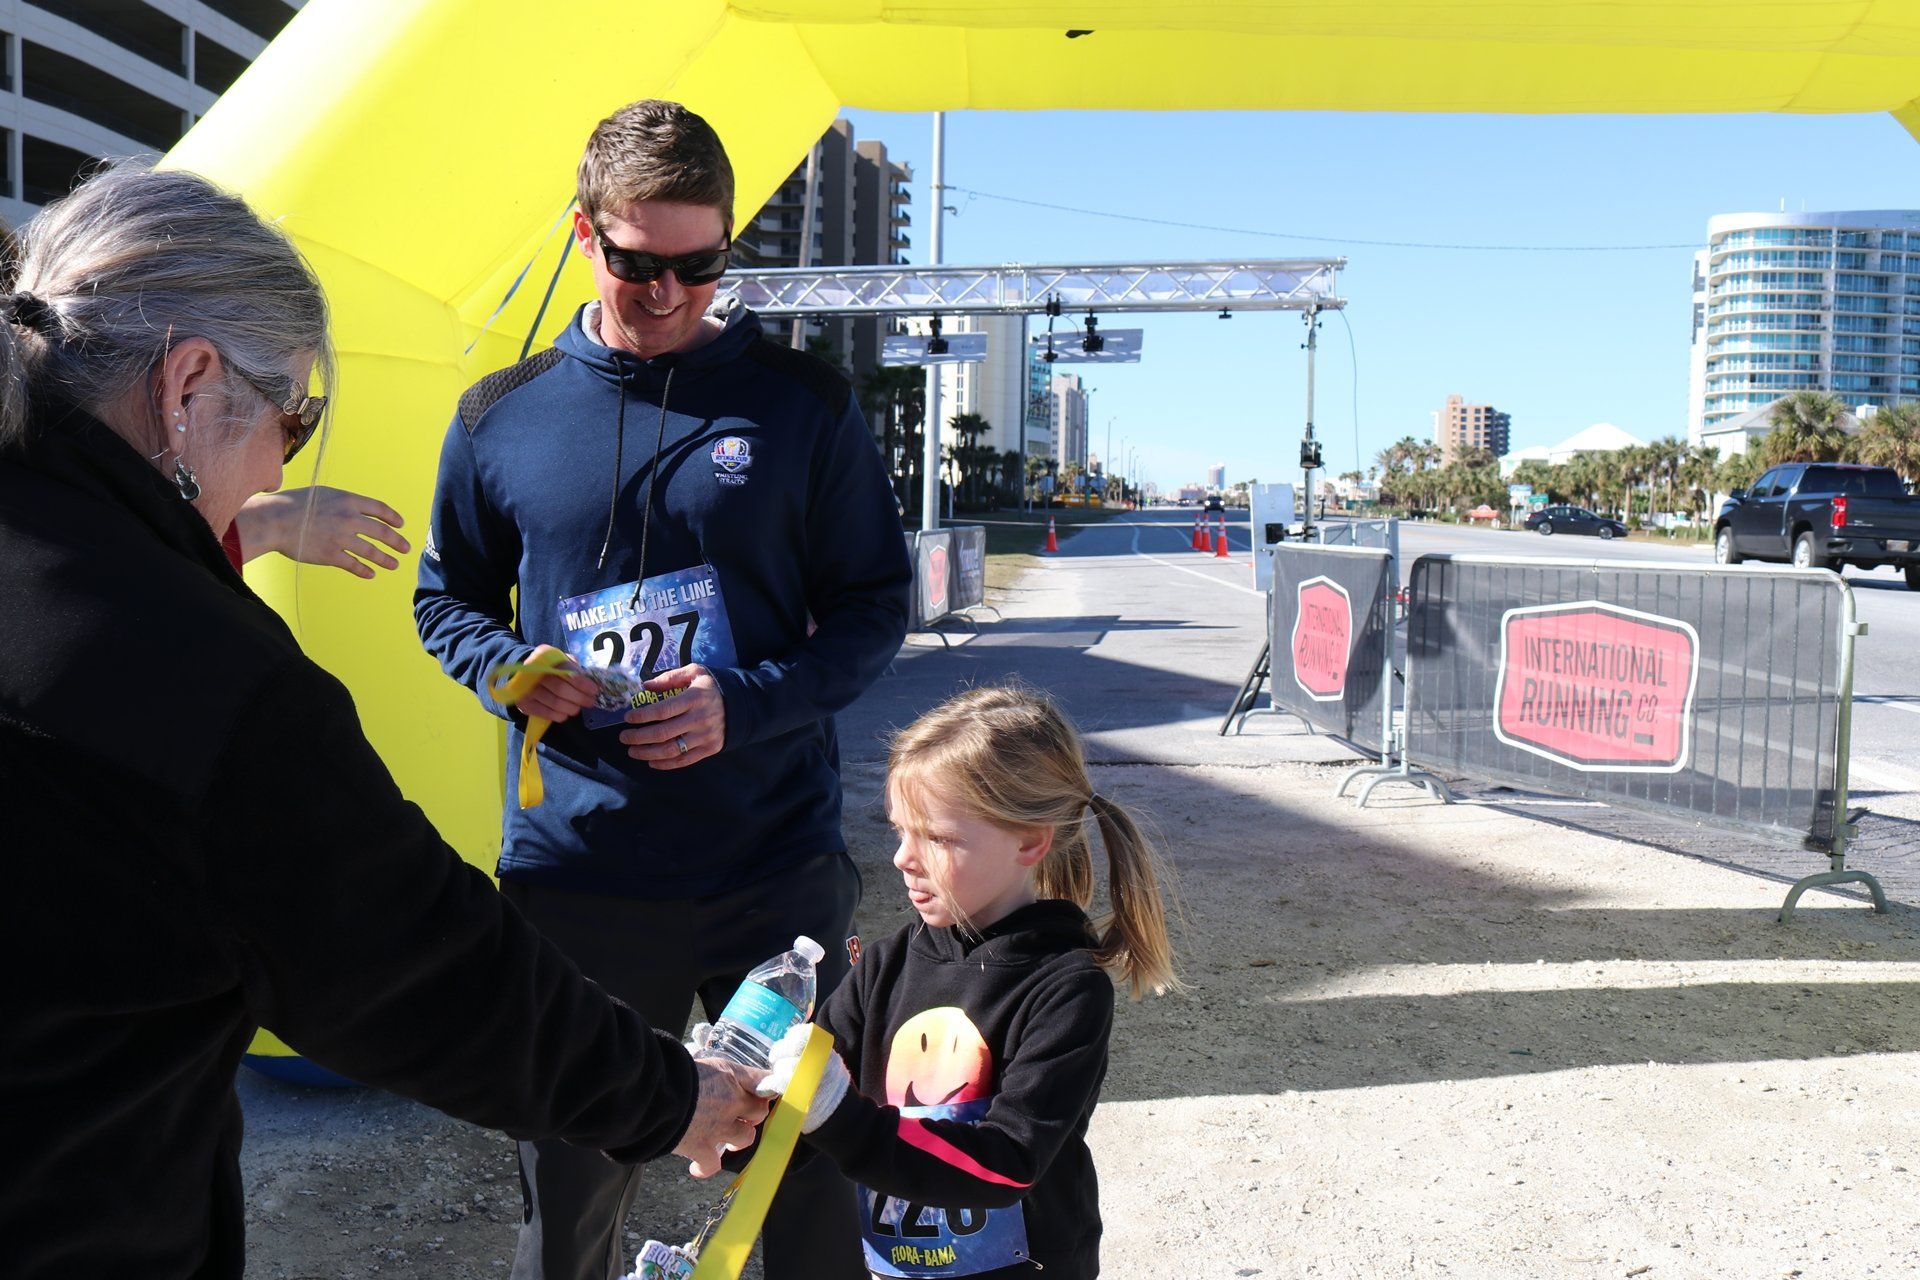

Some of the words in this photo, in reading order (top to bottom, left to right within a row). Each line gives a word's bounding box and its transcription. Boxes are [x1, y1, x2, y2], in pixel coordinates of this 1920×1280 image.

[565, 604, 609, 632] MAKE
[610, 601, 624, 620] IT
[649, 587, 679, 611] THE
[681, 578, 717, 603] LINE
[593, 610, 700, 684] 227
[1525, 636, 1668, 687] INTERNATIONAL
[1519, 677, 1632, 739] RUNNING
[891, 1244, 957, 1267] FLORA-BAMA
